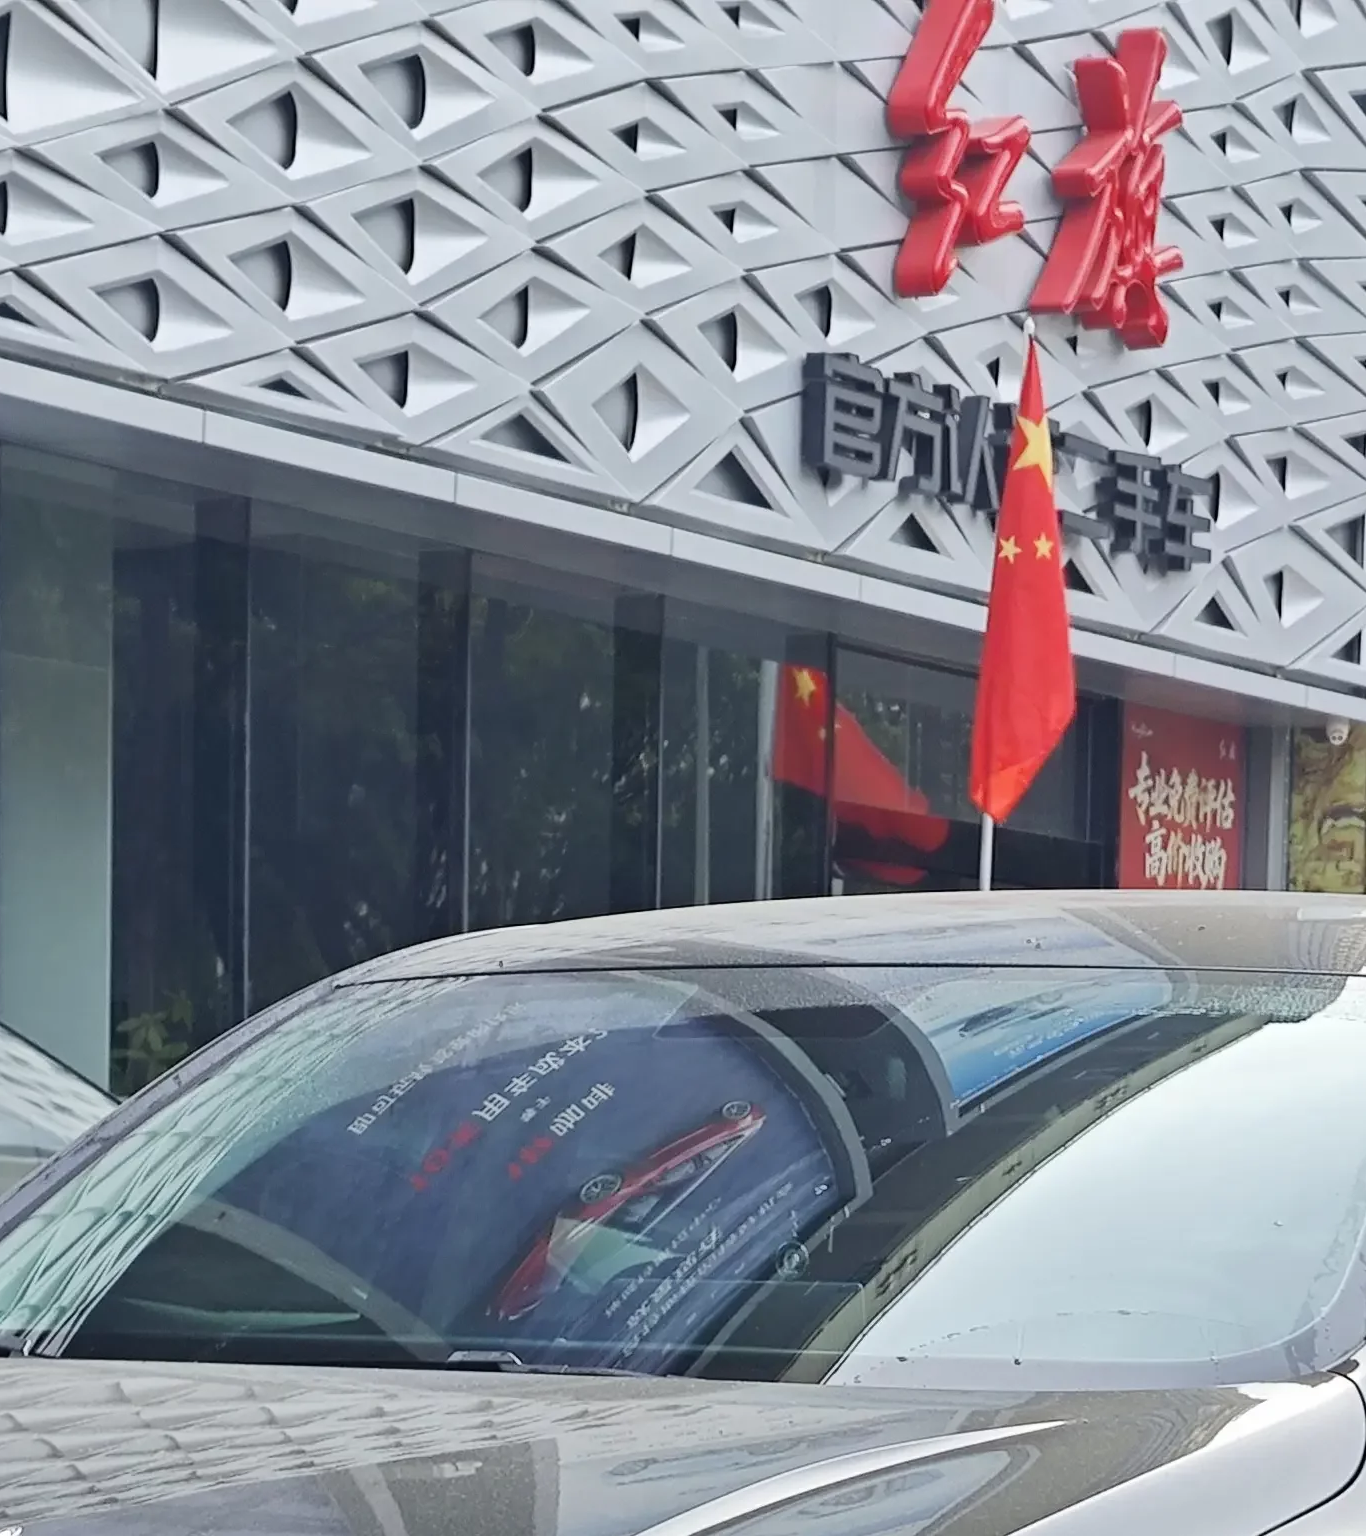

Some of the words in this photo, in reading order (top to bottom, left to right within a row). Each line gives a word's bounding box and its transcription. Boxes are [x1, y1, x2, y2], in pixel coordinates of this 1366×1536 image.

[801, 352, 1213, 576] 官方认二手车
